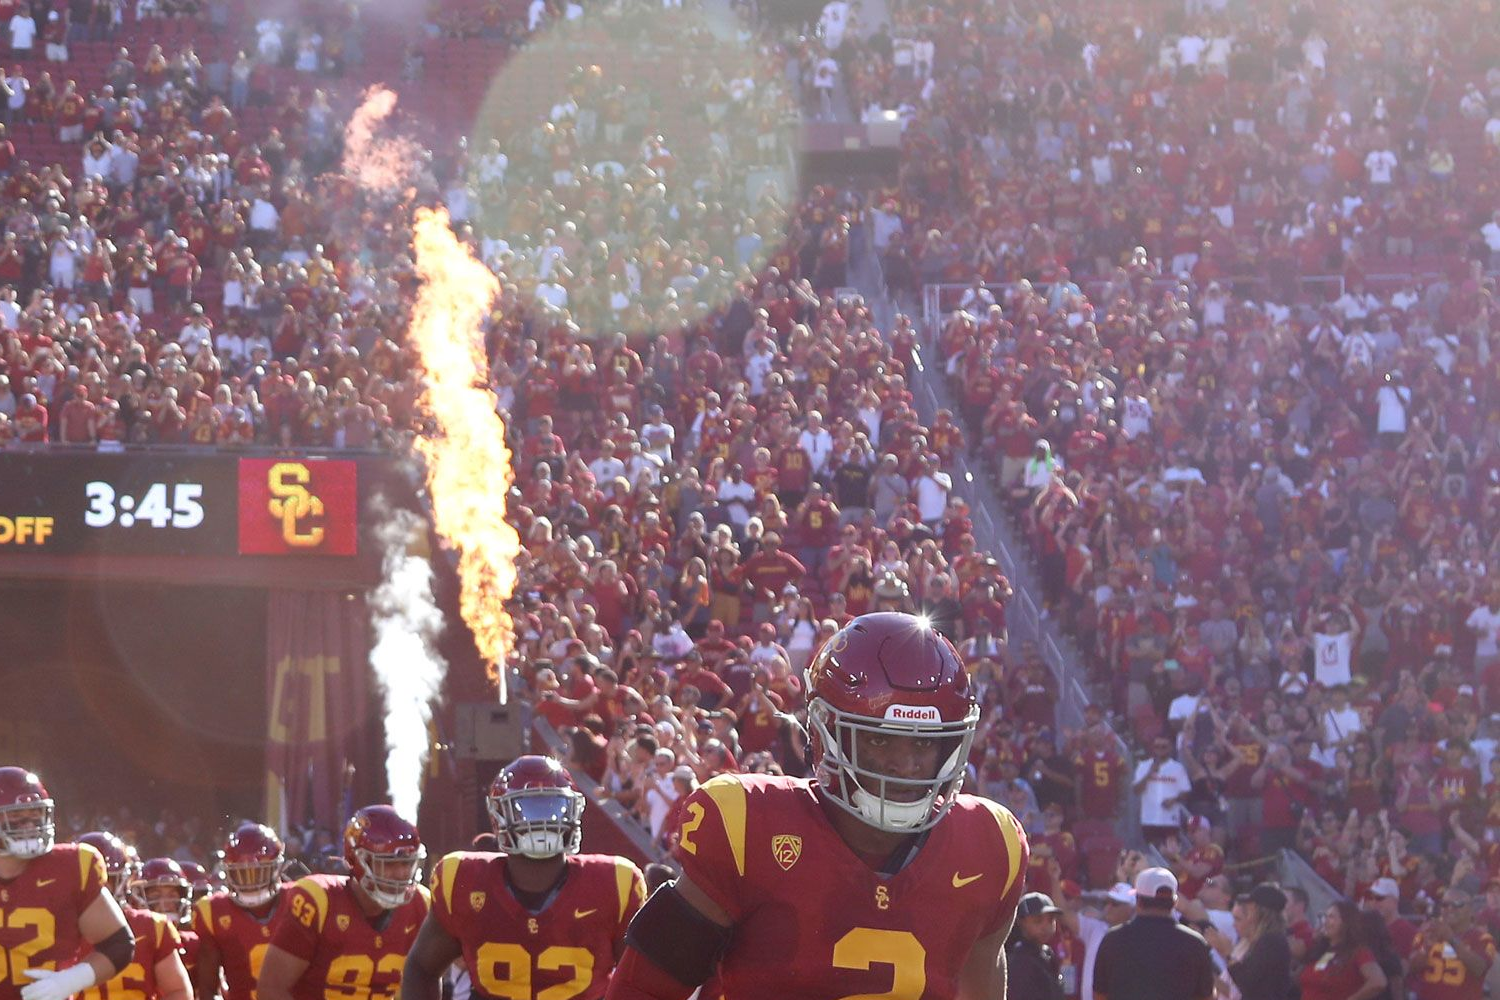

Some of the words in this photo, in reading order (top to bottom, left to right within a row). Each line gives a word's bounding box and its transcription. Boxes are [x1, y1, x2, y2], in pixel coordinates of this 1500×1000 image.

[84, 481, 205, 529] 3:45
[893, 708, 935, 720] Riddell
[679, 801, 706, 856] 2
[779, 849, 794, 863] 12
[291, 893, 316, 927] 93
